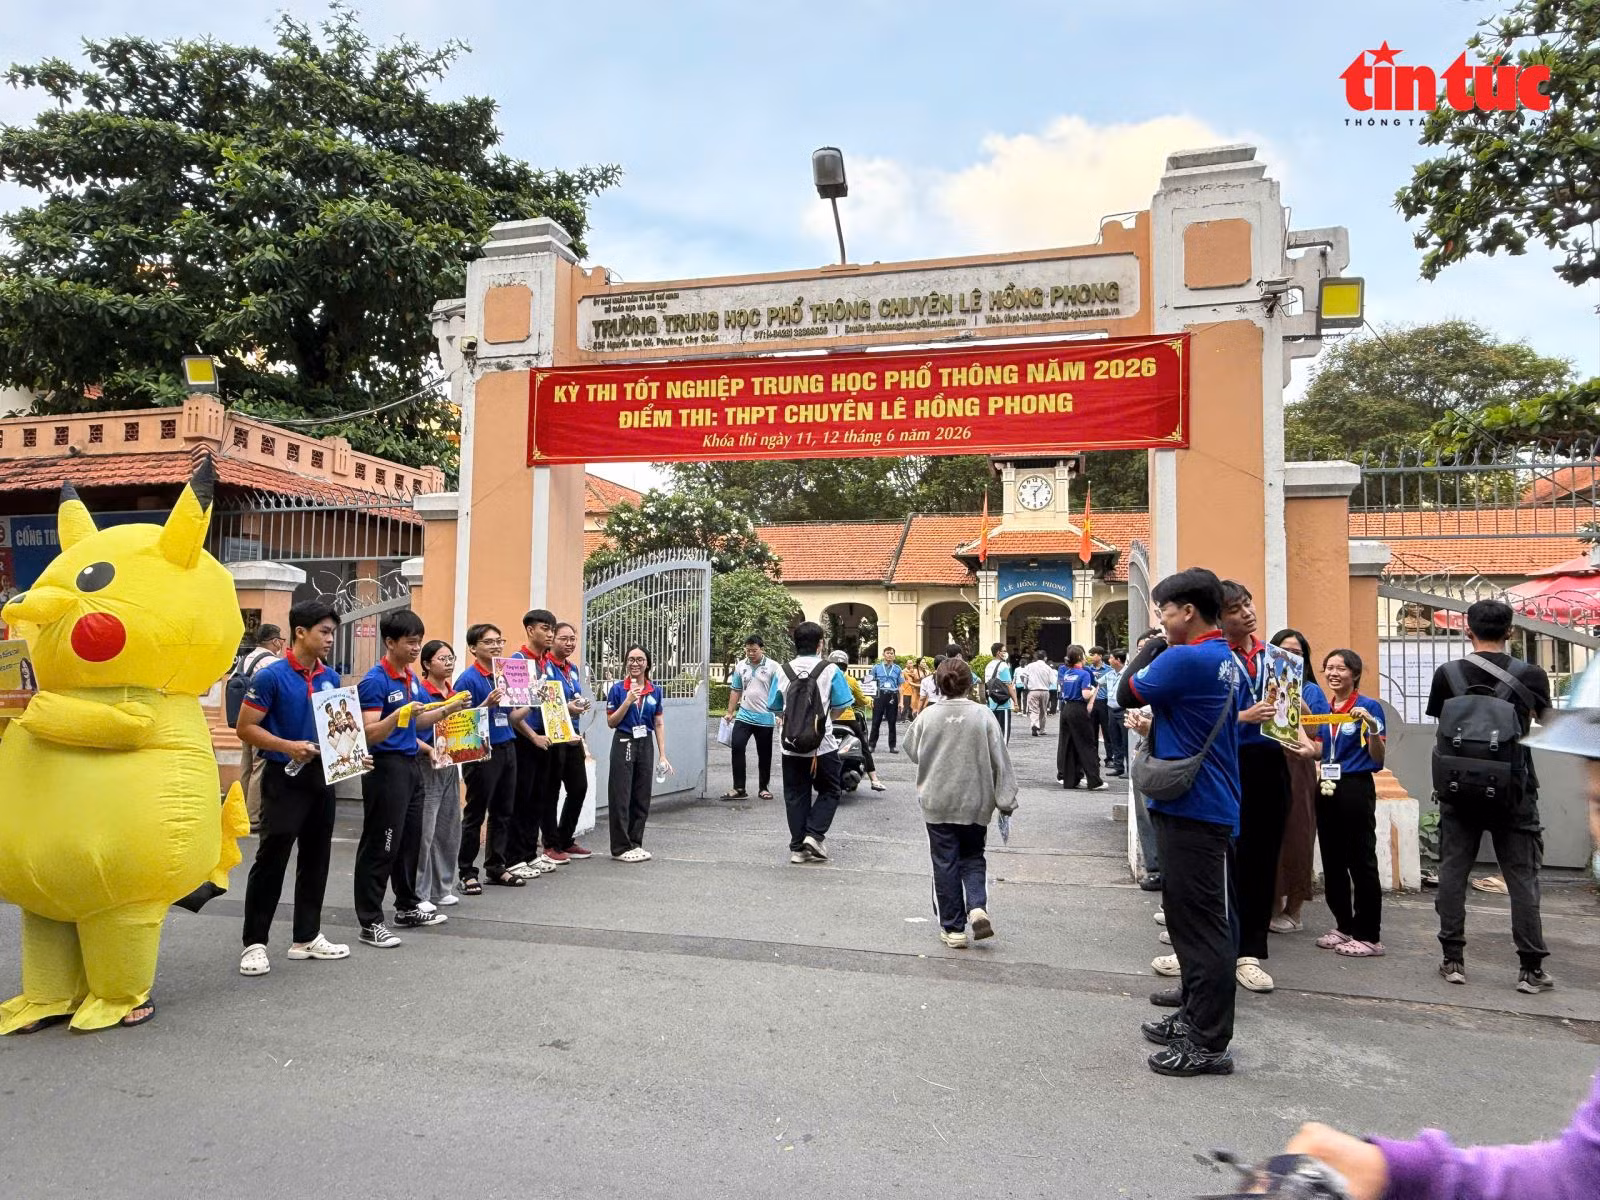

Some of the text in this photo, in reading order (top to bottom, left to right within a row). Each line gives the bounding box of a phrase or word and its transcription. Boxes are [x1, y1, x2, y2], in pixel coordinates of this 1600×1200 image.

[592, 281, 1119, 339] TRƯỜNG TRUNG HỌC PHỔ THÔNG CHUYÊN LÊ HỒNG PHONG
[554, 358, 1157, 402] KỲ THI TỐT NGHIỆP TRUNG HỌC PHỔ THÔNG NĂM 2026
[619, 392, 1073, 429] ĐIỂM THI: THPT CHUYÊN LÊ HỒNG PHONG
[703, 426, 971, 449] Khóa thi ngày 11, 12 tháng 6 năm 2026
[1003, 583, 1014, 592] LÊ
[1042, 580, 1067, 592] PHONG
